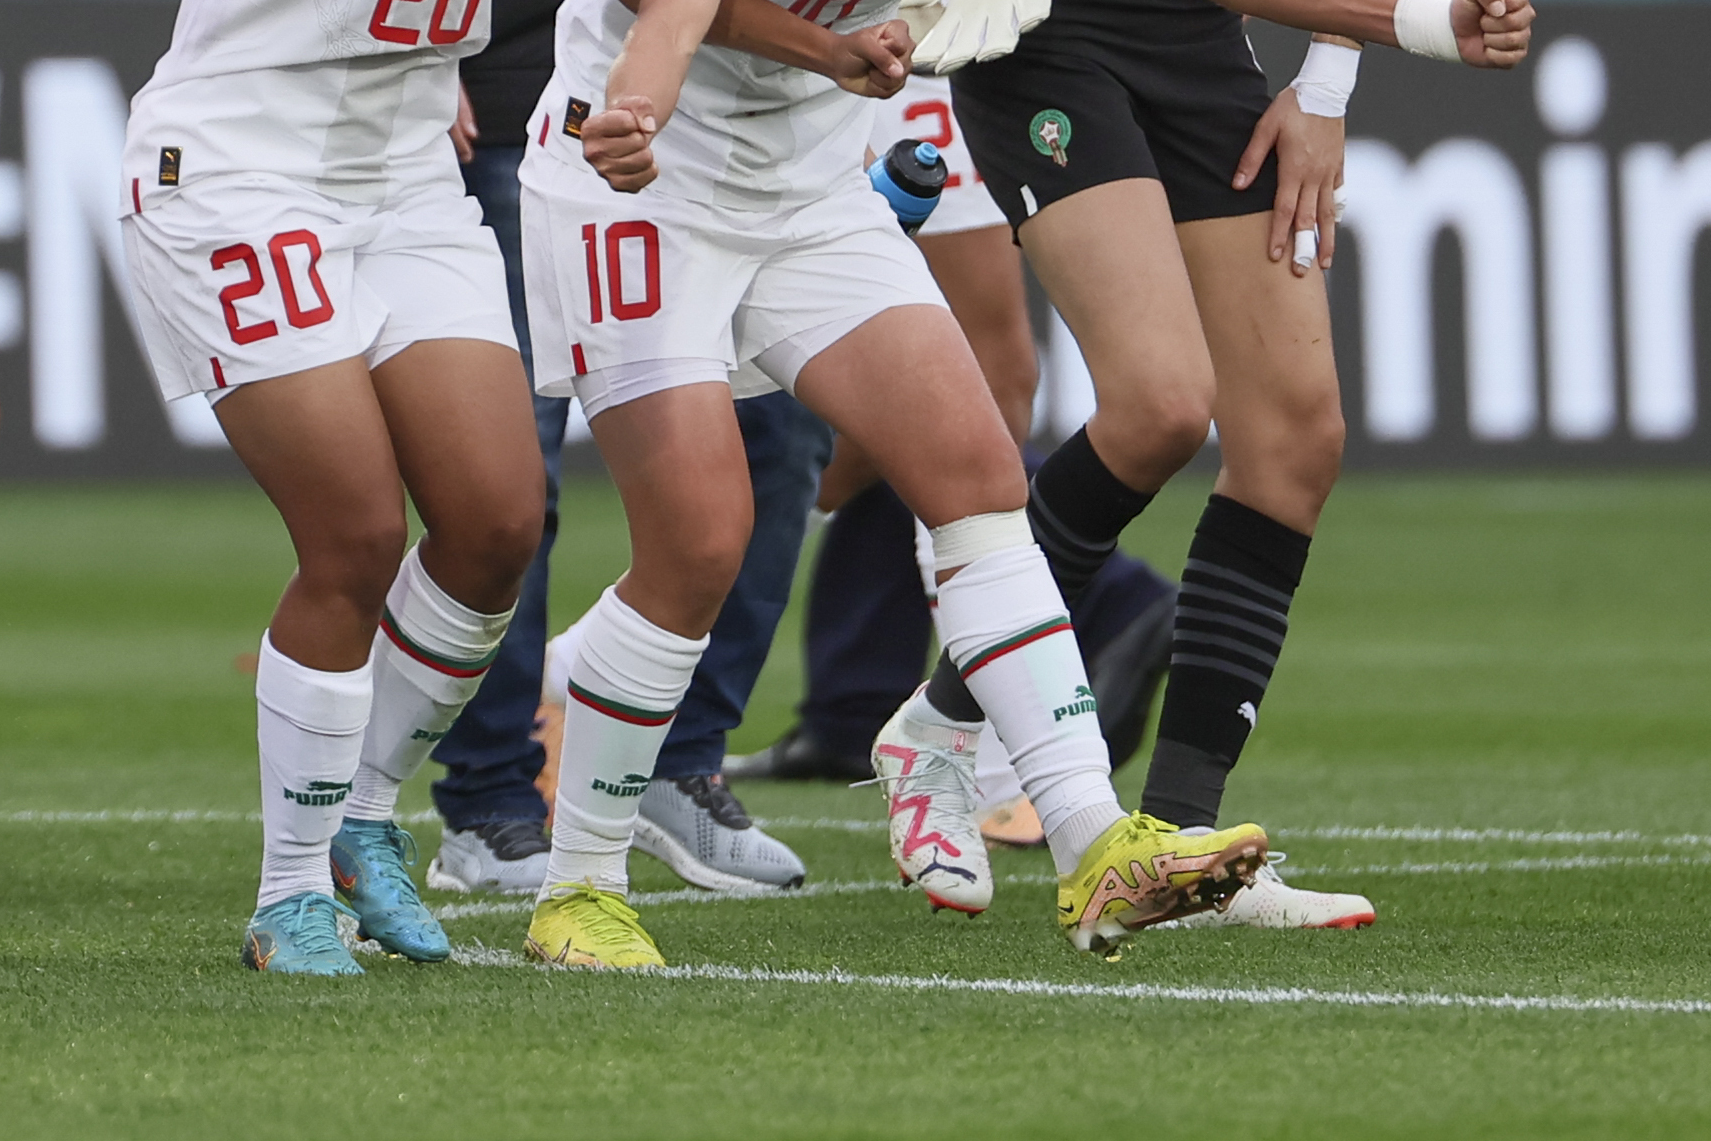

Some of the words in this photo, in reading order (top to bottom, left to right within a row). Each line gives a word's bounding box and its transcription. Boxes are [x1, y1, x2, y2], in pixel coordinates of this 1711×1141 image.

[209, 228, 335, 346] 20
[581, 220, 662, 325] 10
[283, 786, 348, 806] PUMA
